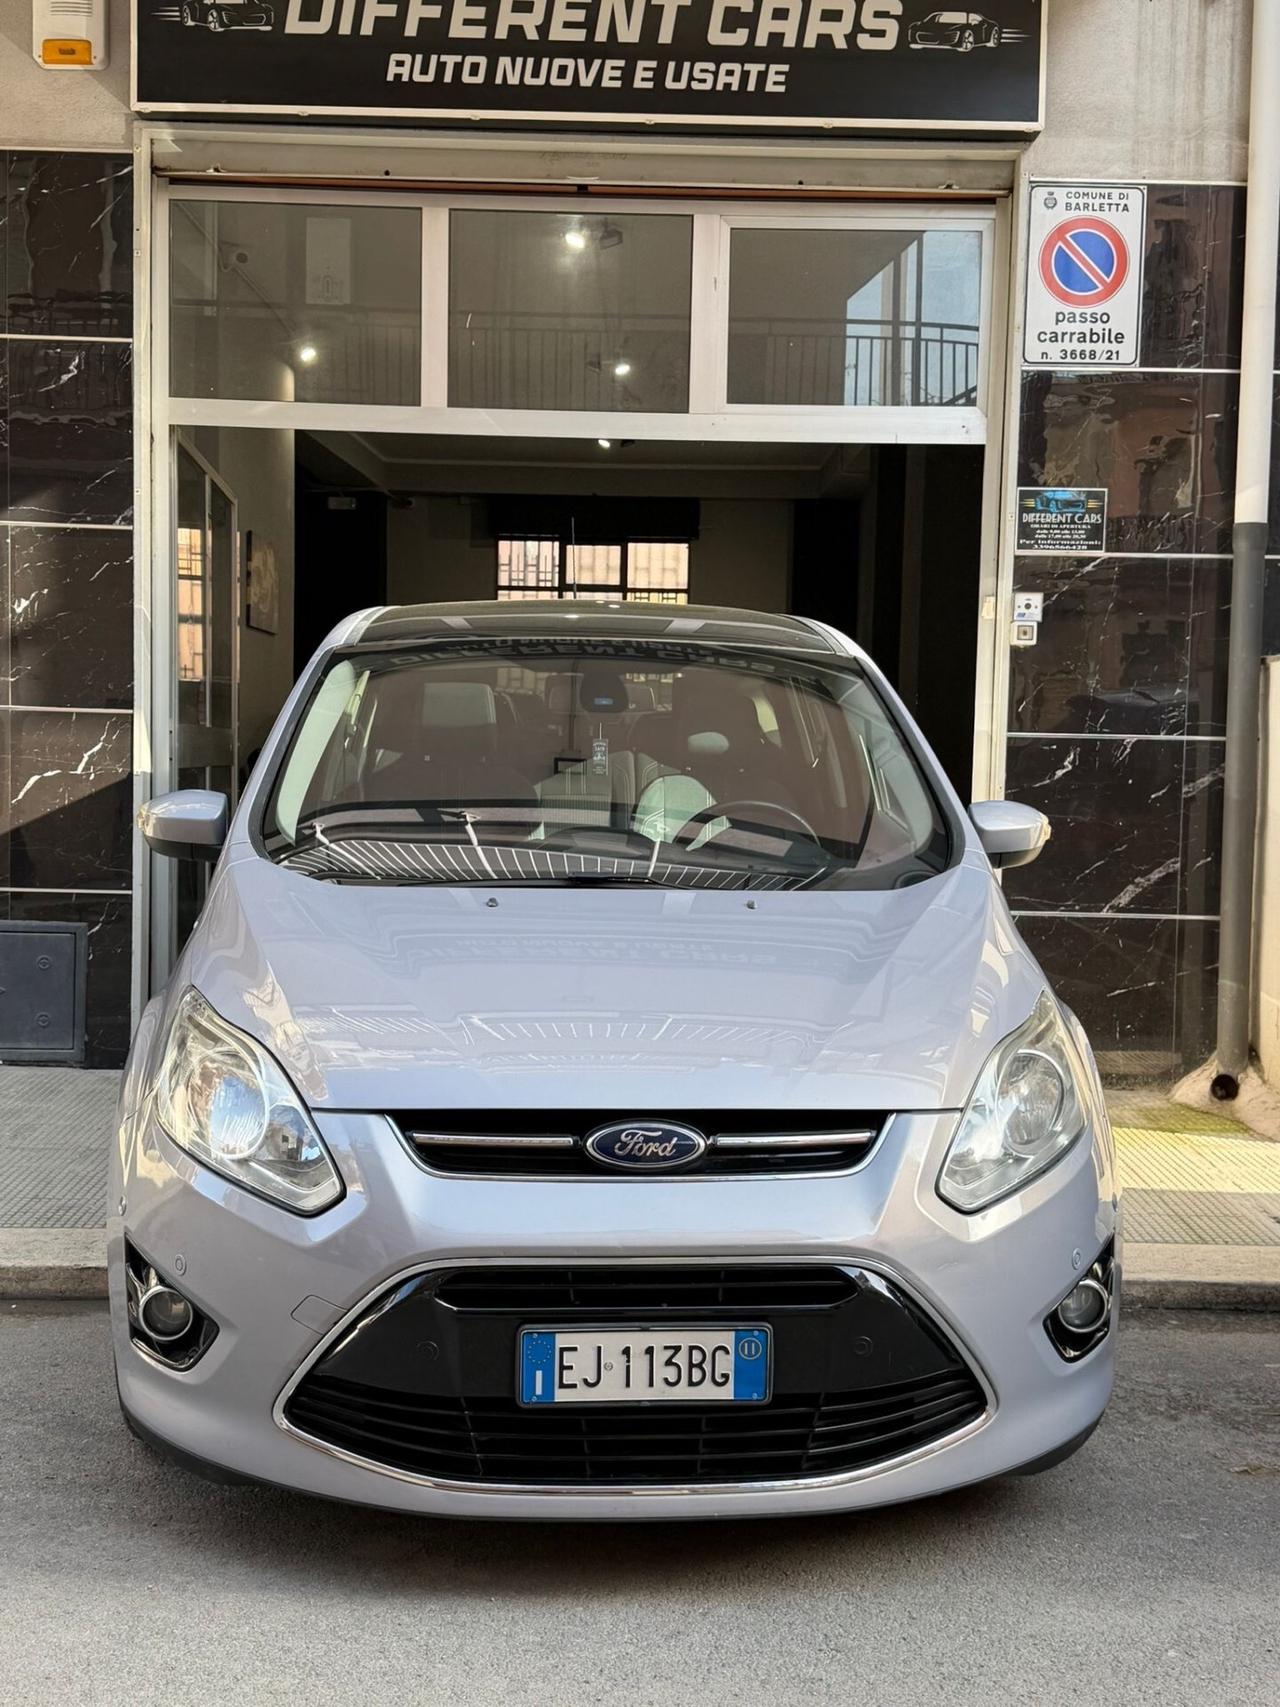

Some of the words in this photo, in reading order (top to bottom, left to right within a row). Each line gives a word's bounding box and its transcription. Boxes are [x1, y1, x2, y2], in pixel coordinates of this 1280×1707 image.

[284, 0, 691, 44] DIFFERENT
[707, 0, 903, 51] CARS
[386, 53, 488, 84] AUTO
[495, 56, 626, 89] NUOVE
[633, 60, 658, 89] E
[664, 61, 790, 93] USATE
[1066, 191, 1113, 201] COMUNE
[1118, 193, 1129, 201] DI
[1065, 202, 1129, 213] BARLETTA
[1055, 311, 1111, 326] passo
[1037, 328, 1125, 344] carrabile
[1041, 351, 1053, 361] n.
[1060, 349, 1120, 361] 3668/21
[1022, 512, 1073, 523] DIFFERENT
[1074, 513, 1102, 524] CARS
[614, 1129, 678, 1156] Ford
